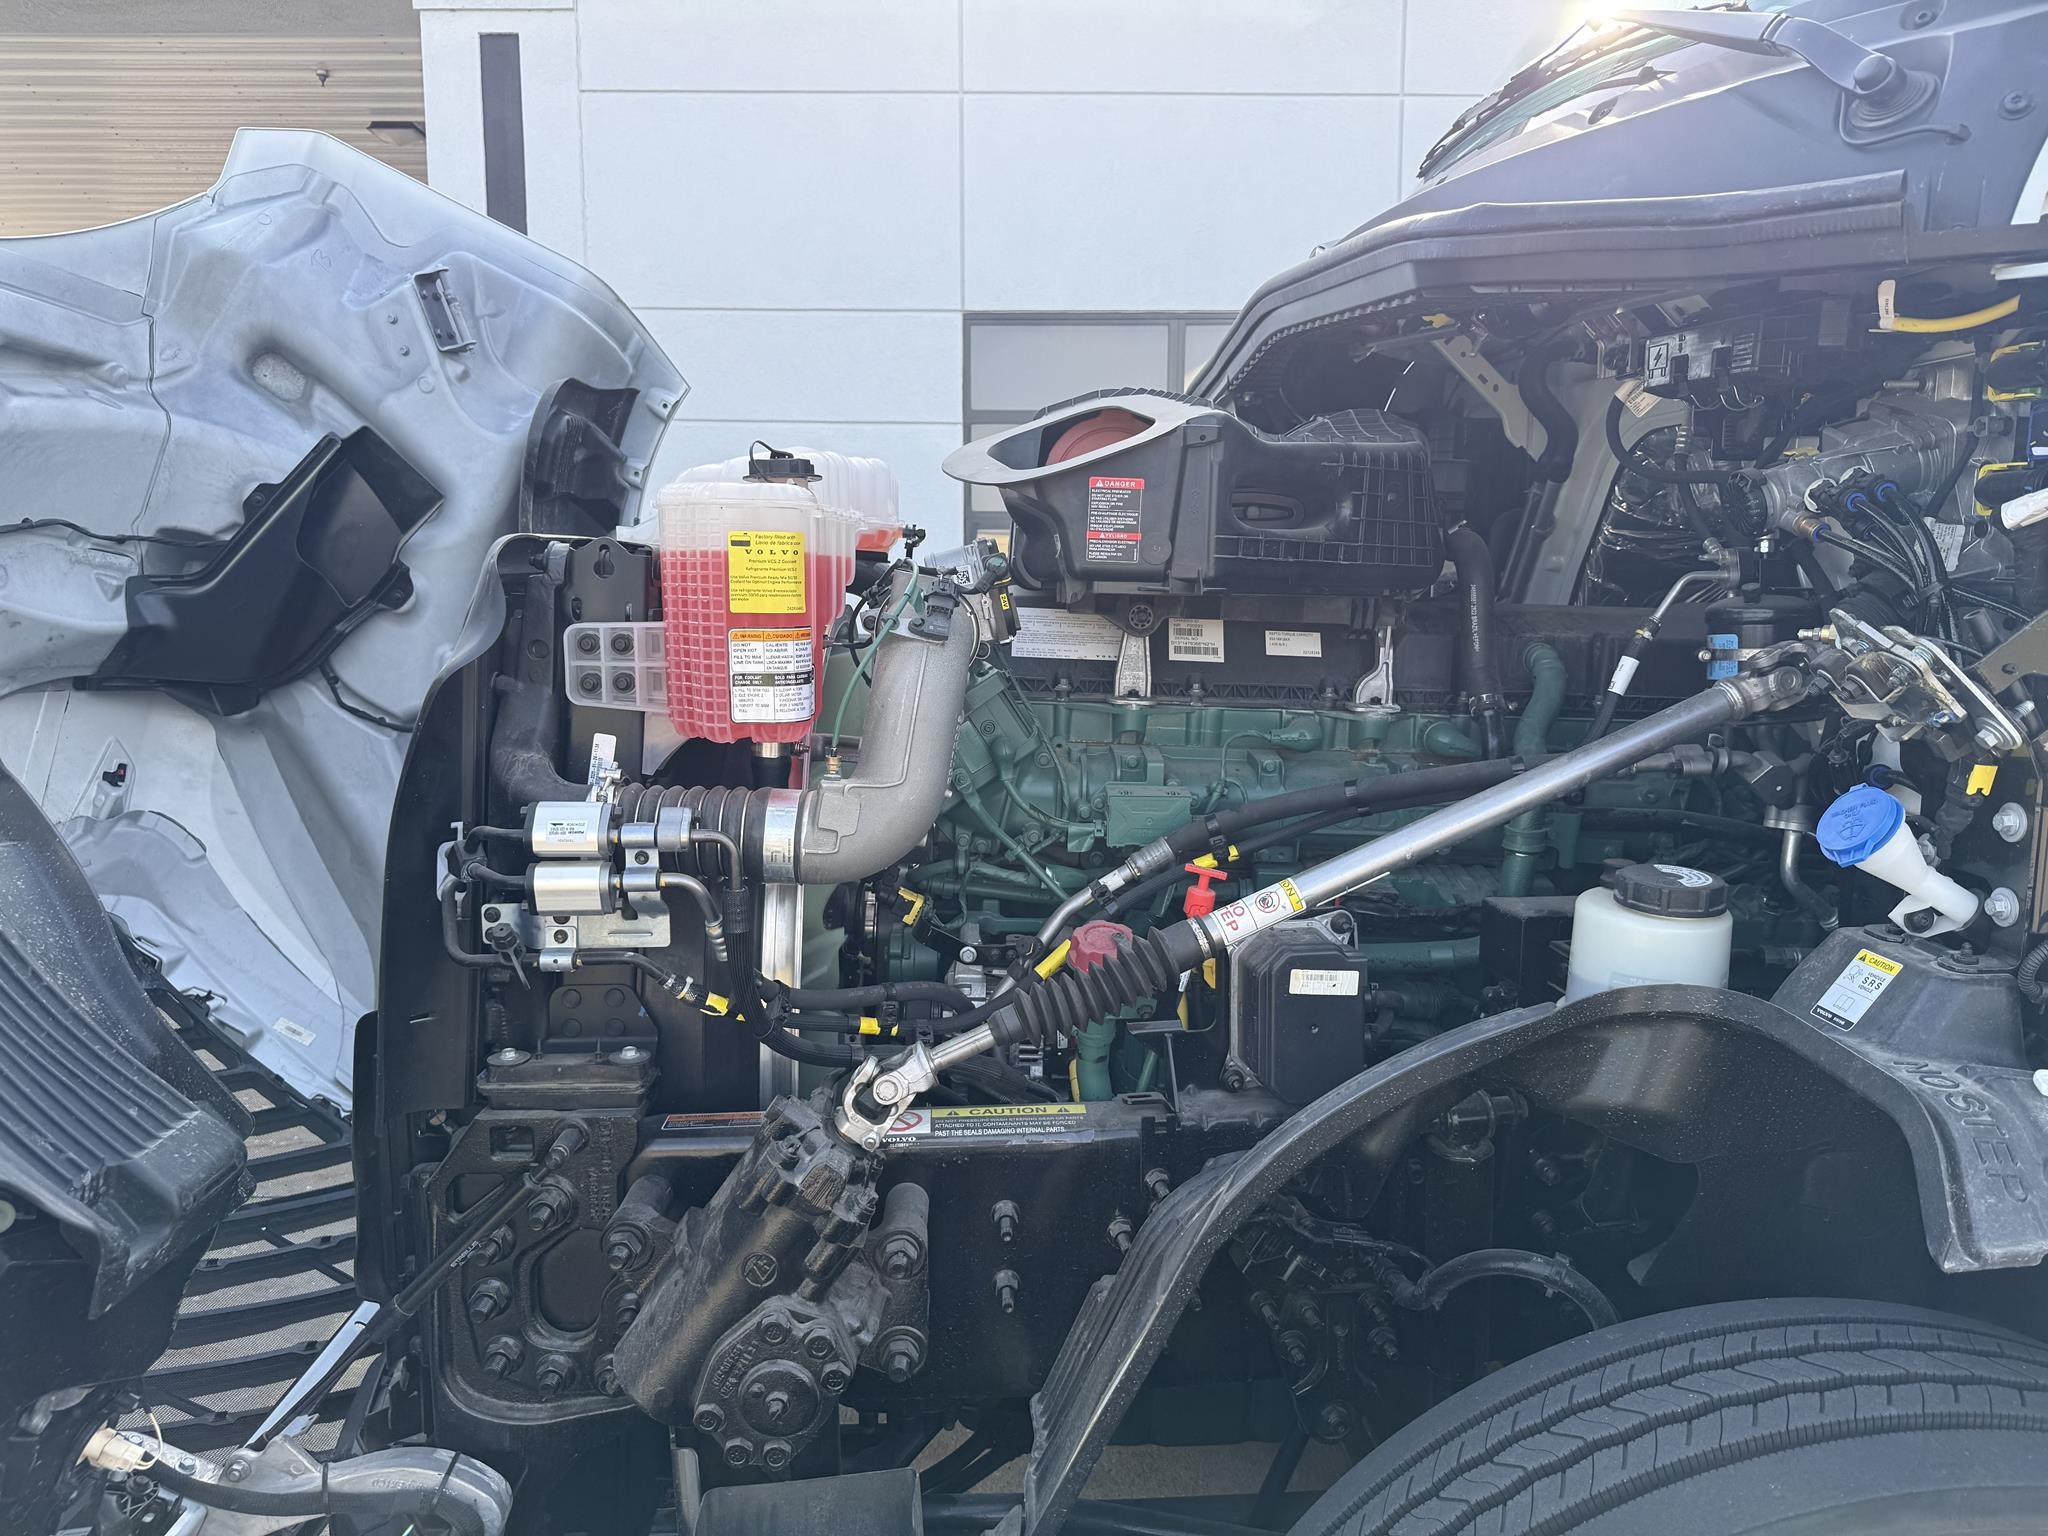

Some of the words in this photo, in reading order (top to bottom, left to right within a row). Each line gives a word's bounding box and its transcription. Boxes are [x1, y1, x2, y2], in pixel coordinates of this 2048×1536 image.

[1001, 596, 1009, 607] 24V
[1868, 957, 1896, 972] CAUTION
[1861, 976, 1883, 990] SRS
[1893, 1061, 1960, 1089] NO
[969, 1106, 1047, 1115] CAUTION
[983, 1127, 1016, 1135] DAMAGING
[1945, 1093, 2029, 1202] STEP
